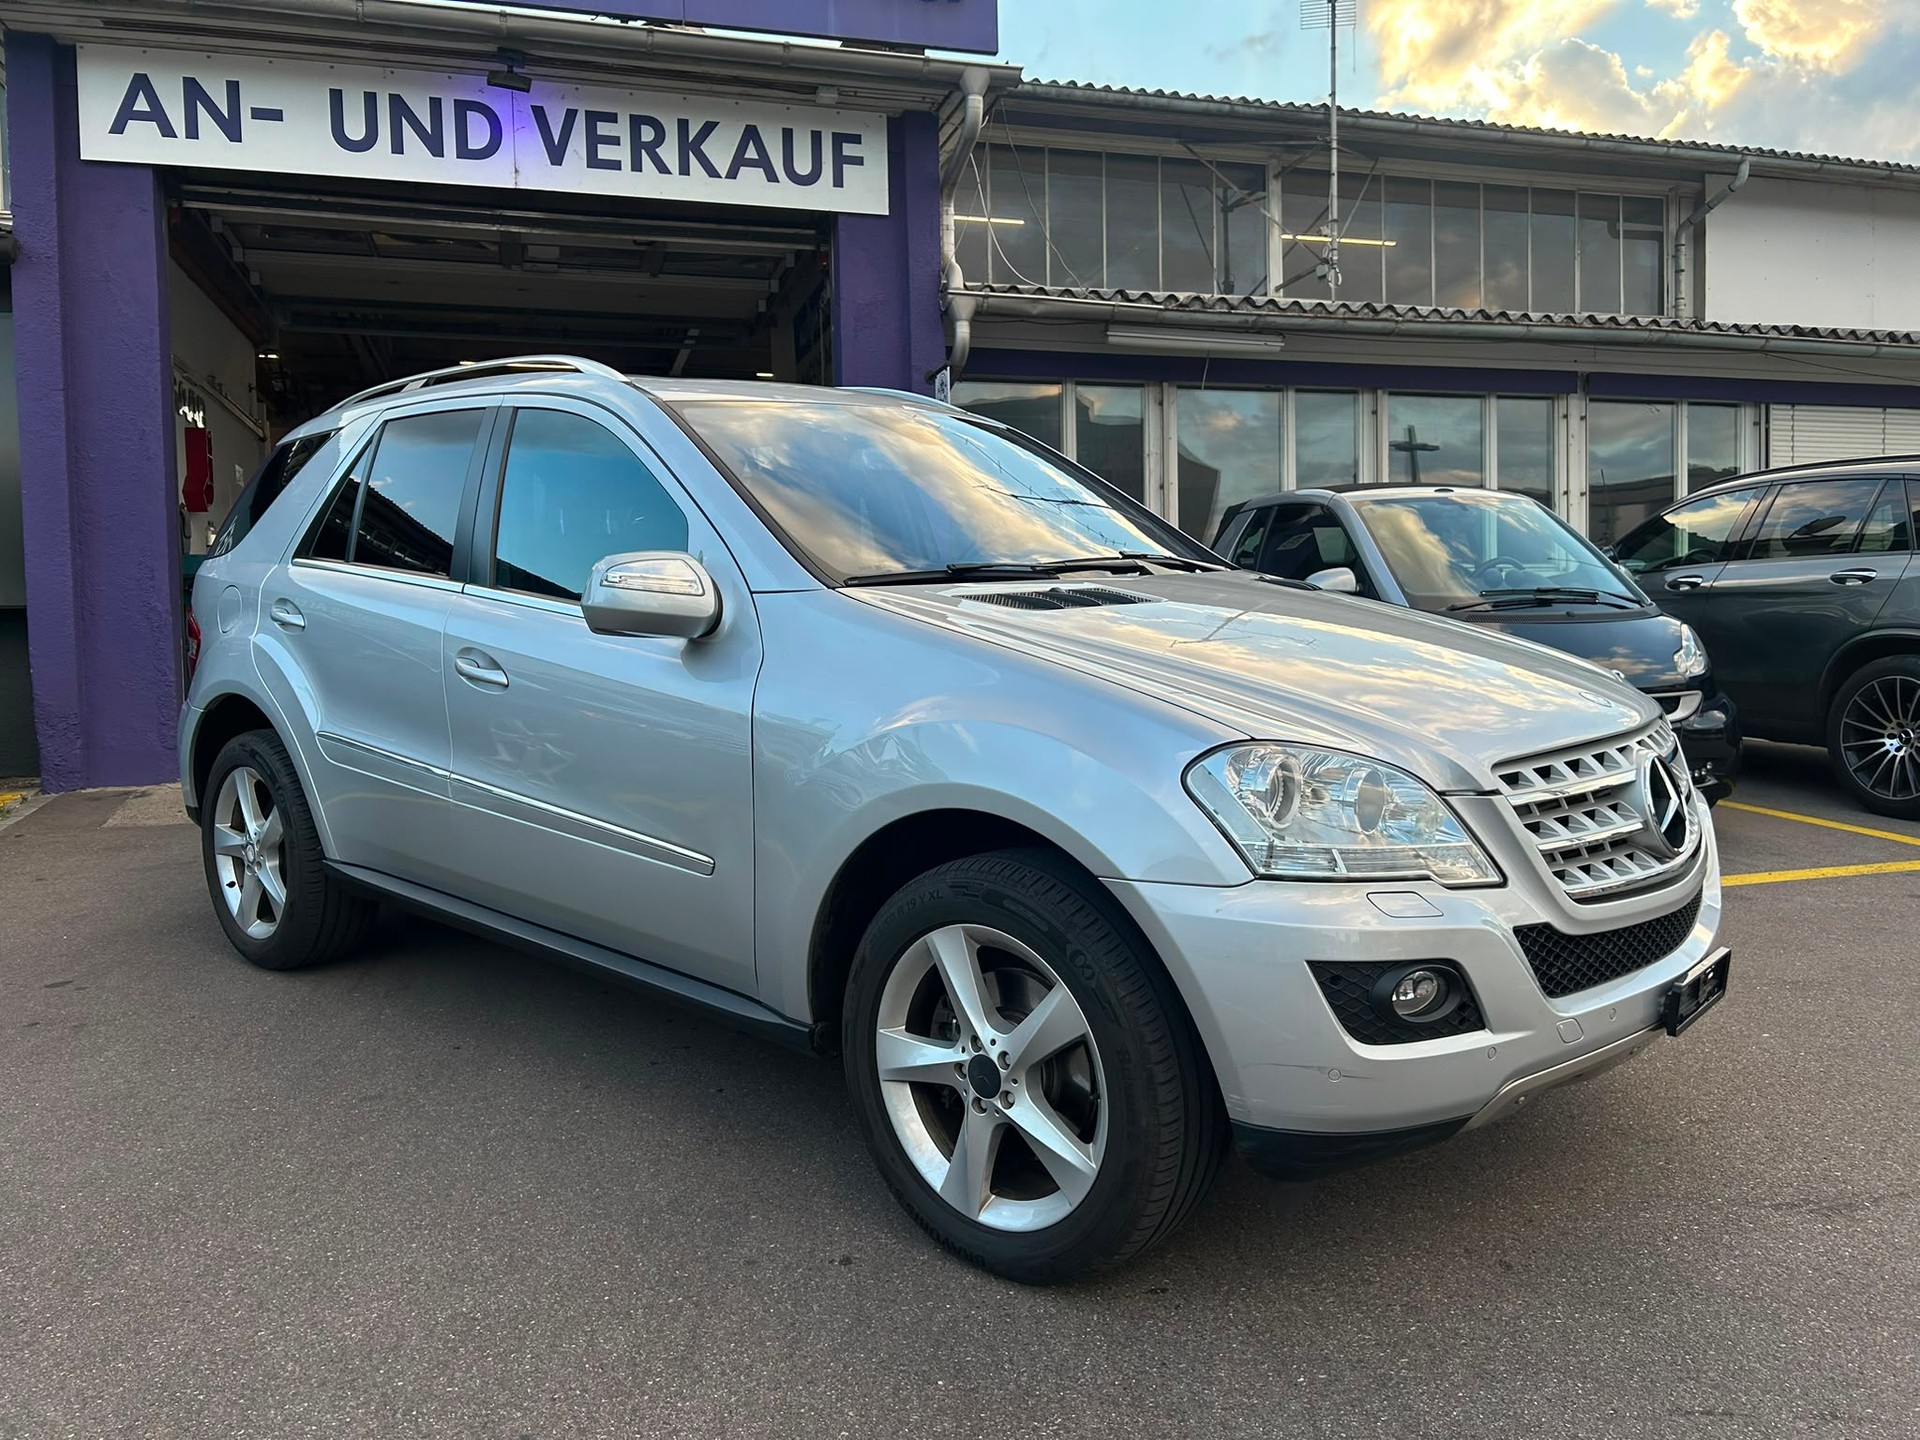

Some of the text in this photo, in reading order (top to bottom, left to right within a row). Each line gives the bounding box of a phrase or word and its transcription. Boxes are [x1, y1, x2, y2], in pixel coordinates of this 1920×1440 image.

[108, 72, 865, 189] AN- UND VERKAUF
